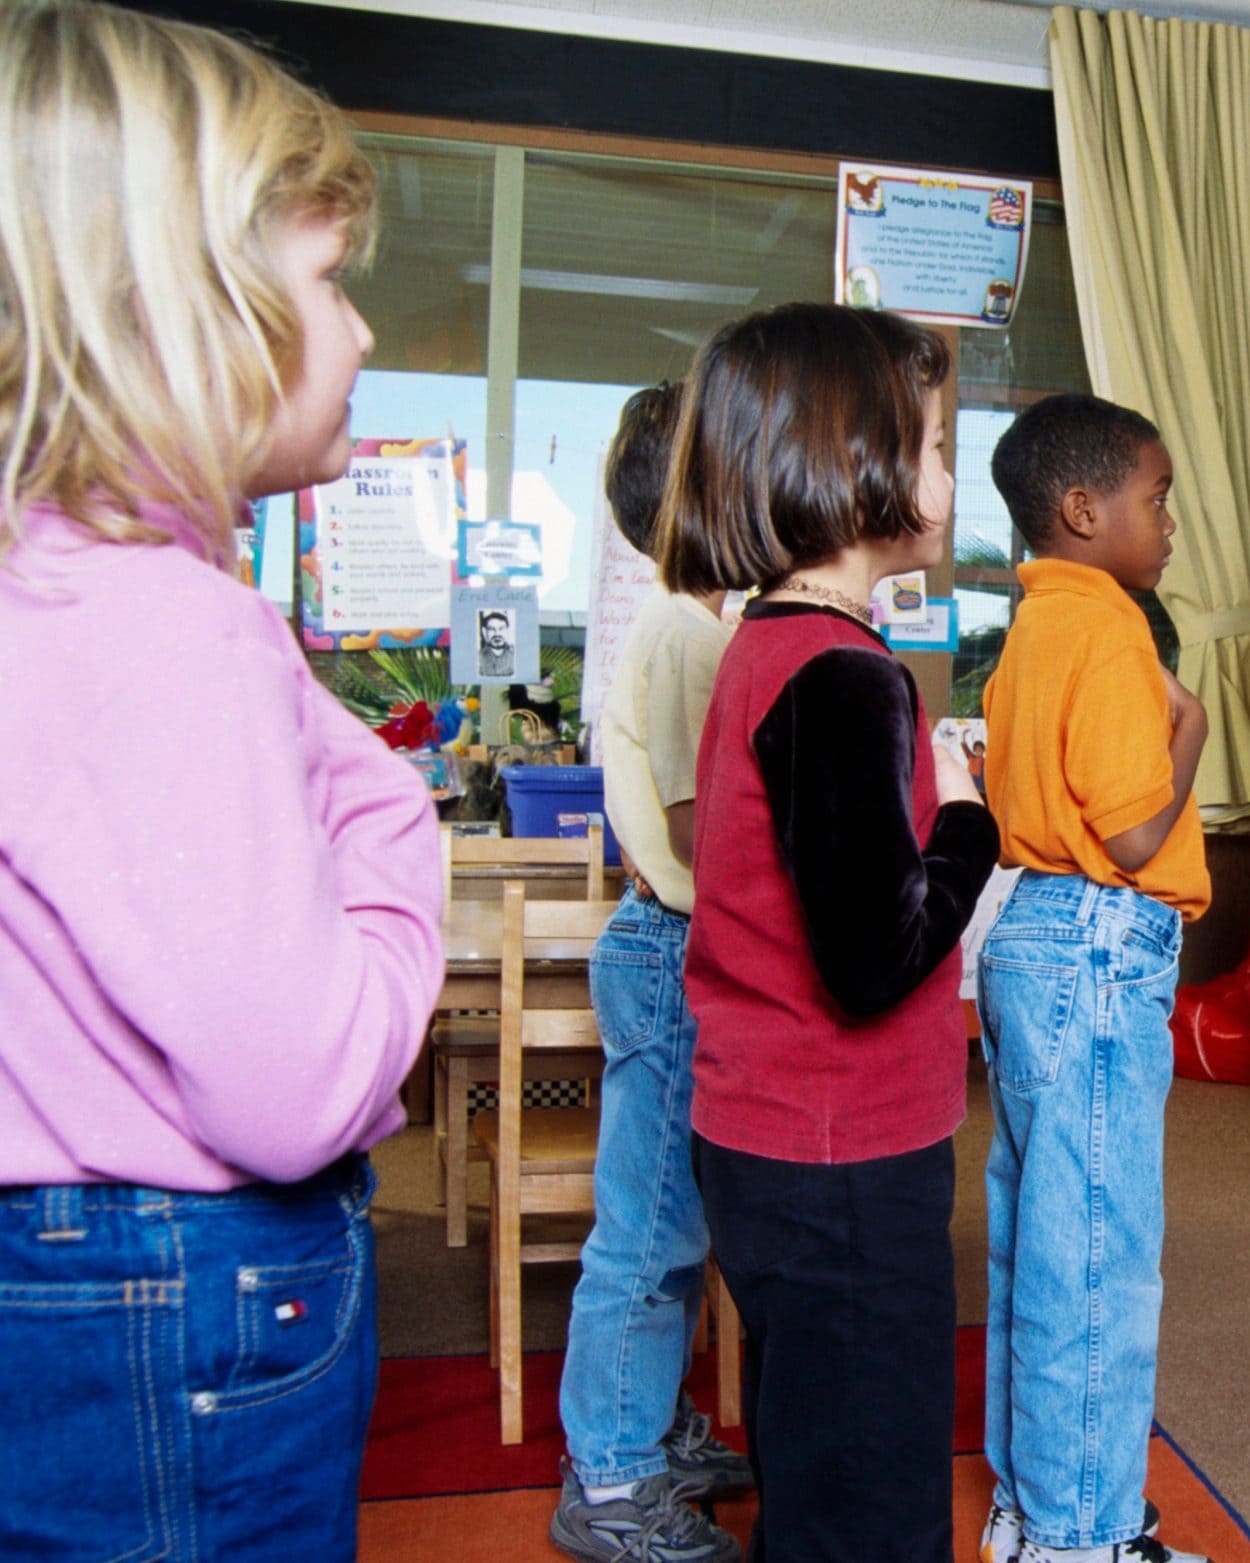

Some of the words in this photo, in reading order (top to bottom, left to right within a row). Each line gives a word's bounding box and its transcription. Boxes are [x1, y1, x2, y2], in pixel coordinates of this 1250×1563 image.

[892, 195, 925, 209] Pledge
[927, 199, 939, 209] to
[941, 198, 957, 210] The
[960, 200, 982, 214] Flag
[355, 482, 414, 497] Rules
